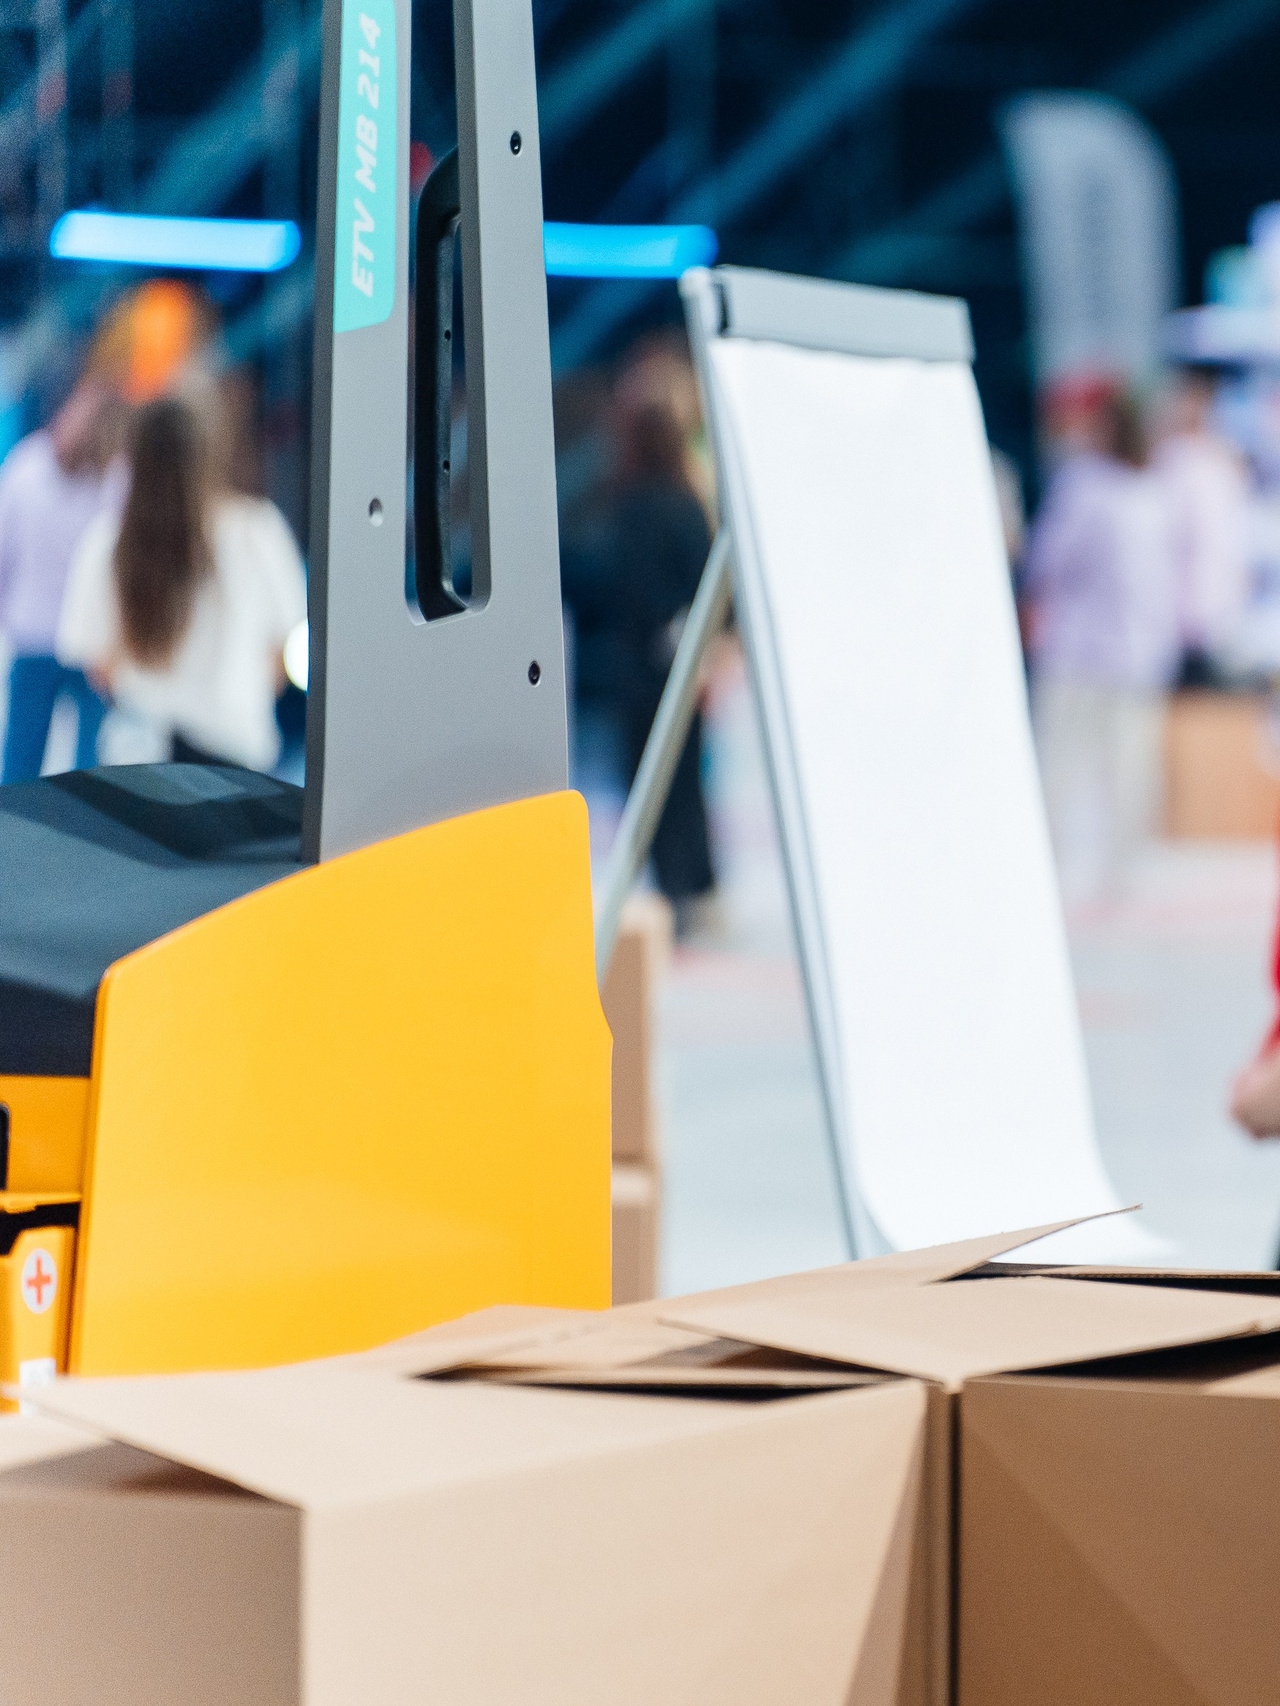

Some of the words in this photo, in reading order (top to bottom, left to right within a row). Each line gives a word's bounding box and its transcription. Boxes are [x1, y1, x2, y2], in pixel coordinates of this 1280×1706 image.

[357, 12, 381, 110] 214
[354, 114, 378, 193] MB
[351, 197, 375, 298] ETV
